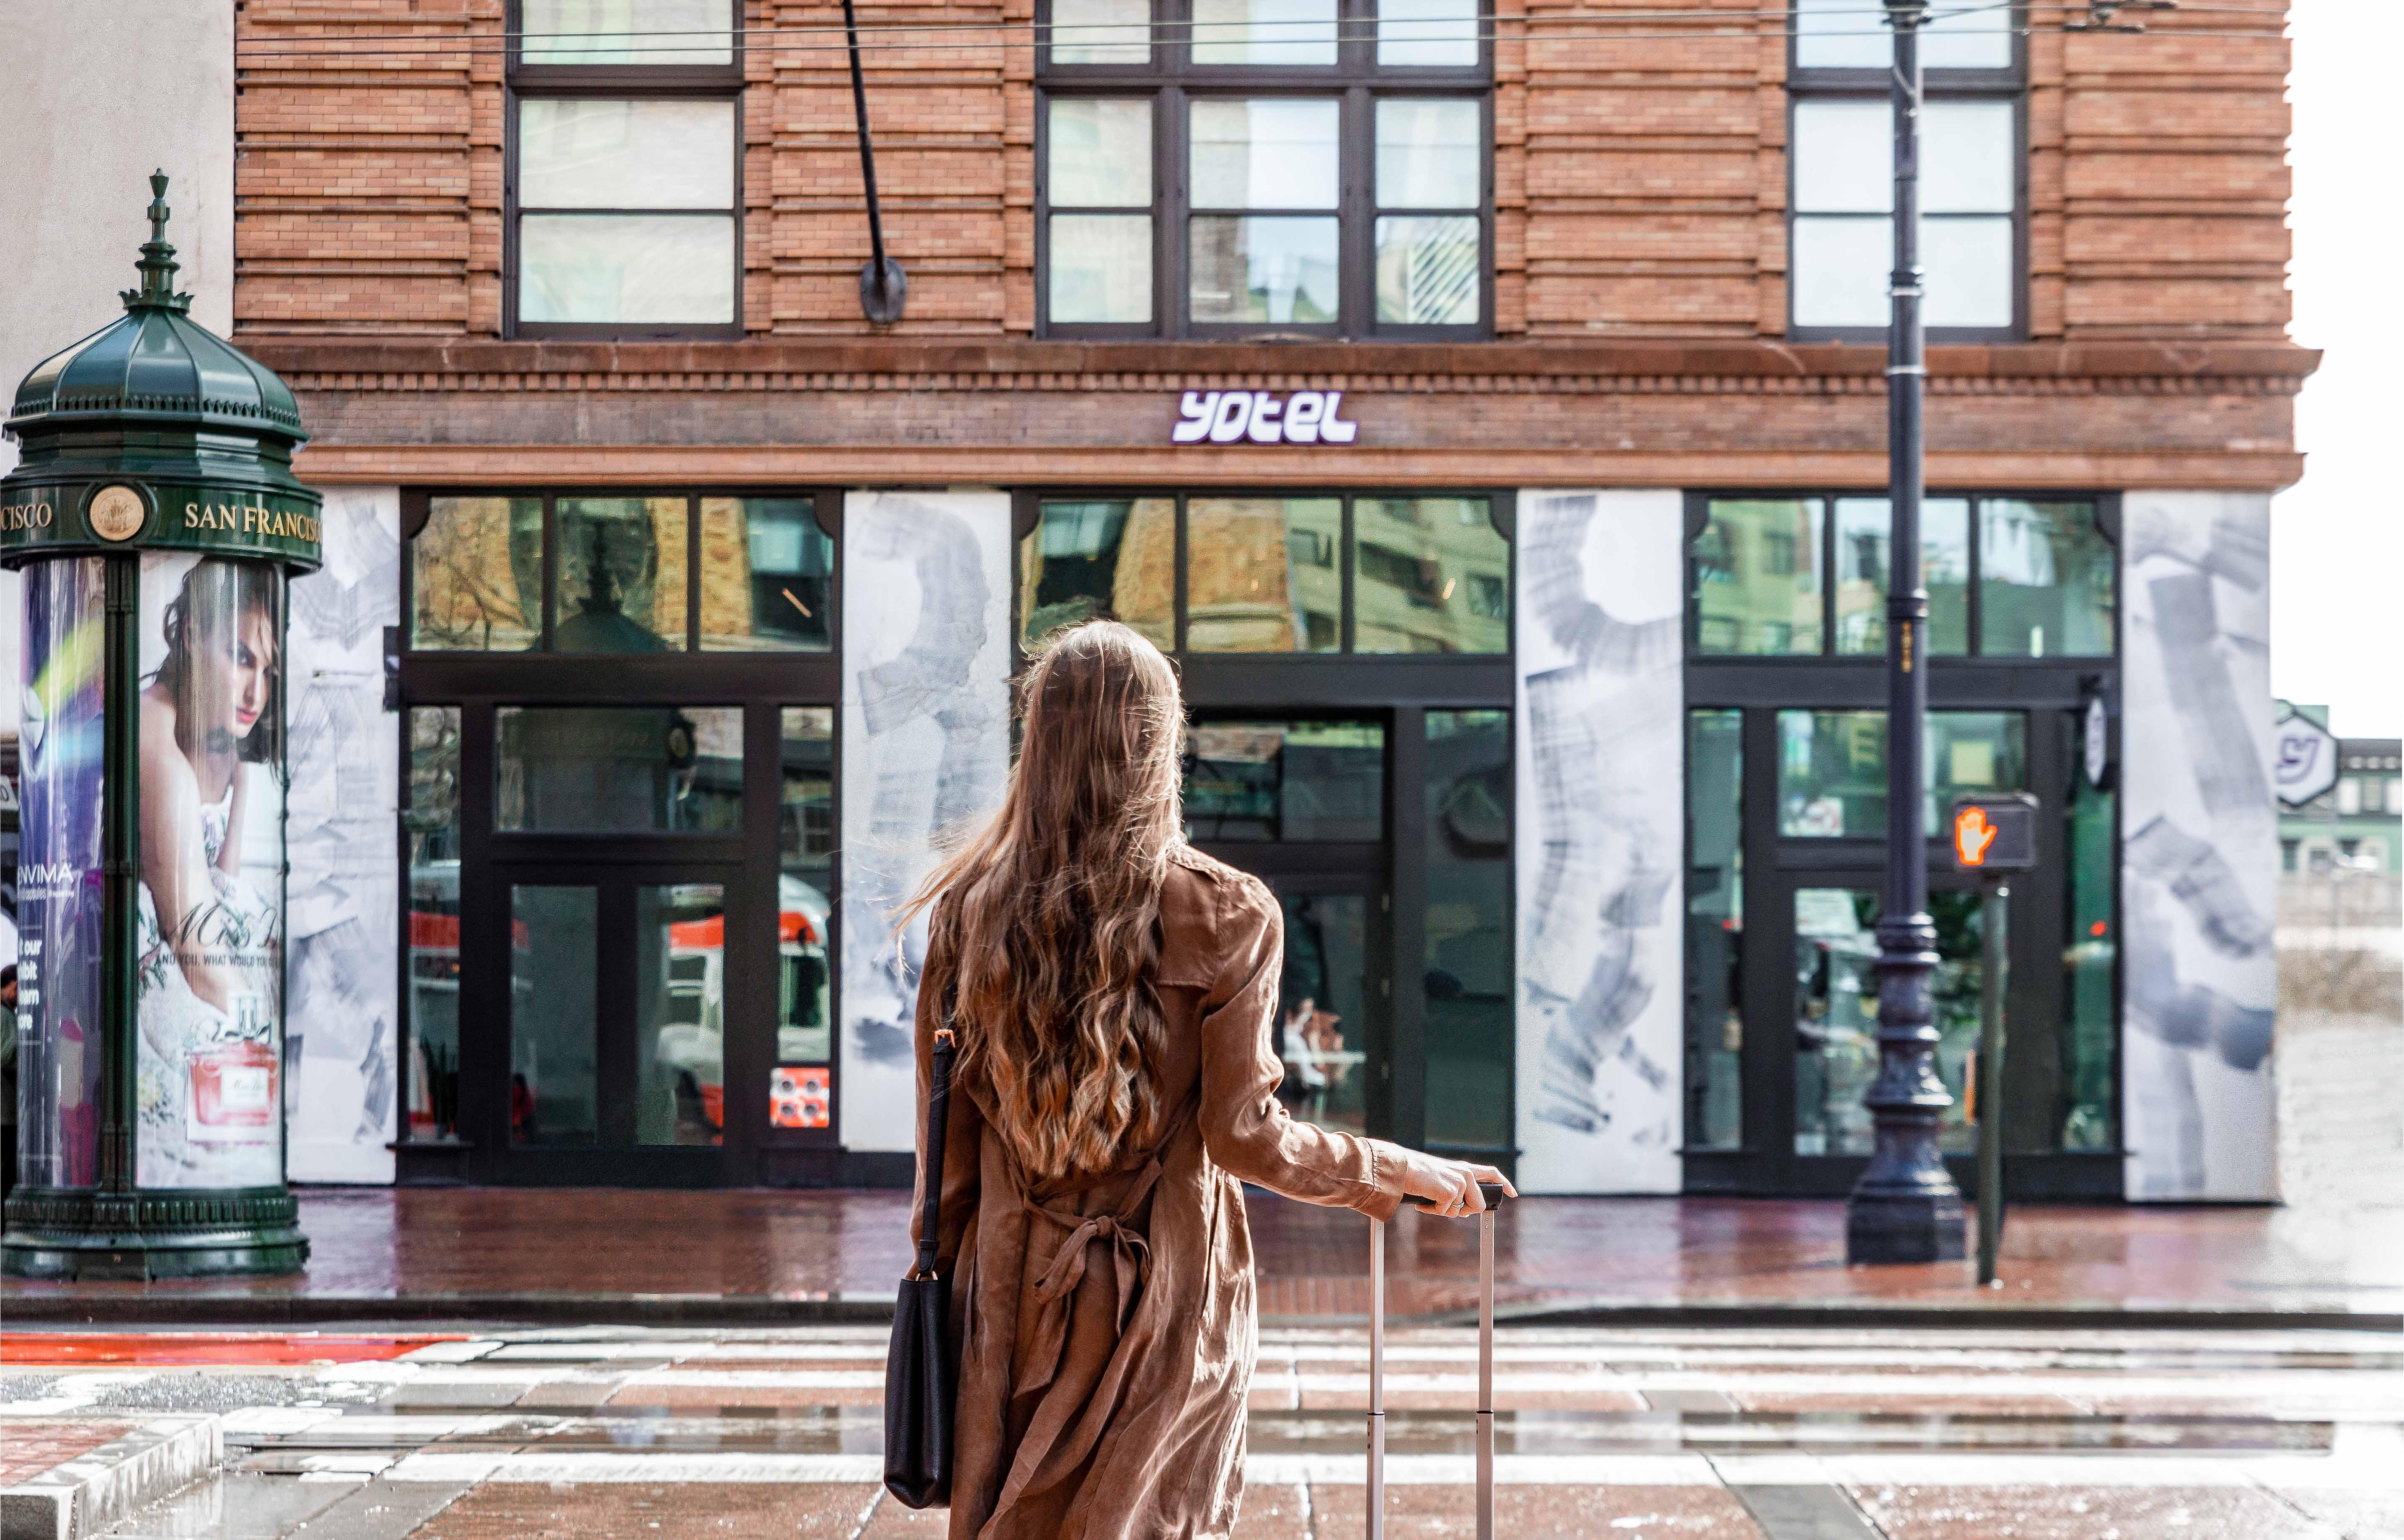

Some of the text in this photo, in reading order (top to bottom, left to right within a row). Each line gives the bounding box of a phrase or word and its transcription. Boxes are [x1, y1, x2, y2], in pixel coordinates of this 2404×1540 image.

[185, 502, 237, 530] SAN
[204, 954, 227, 966] WHAT
[230, 954, 255, 967] WOULD
